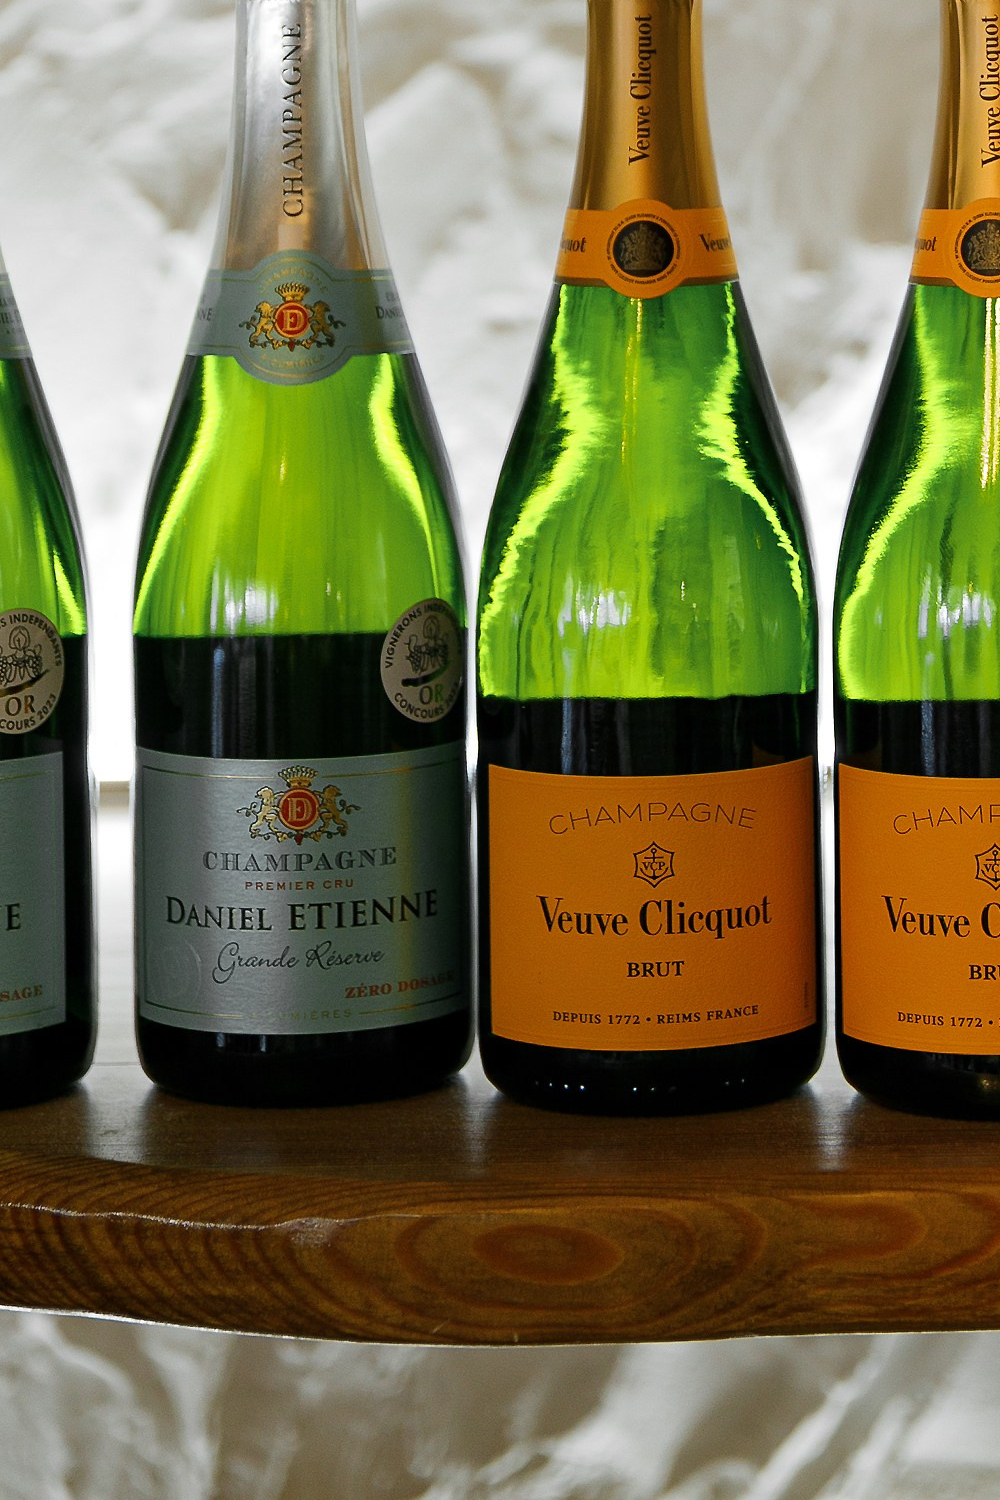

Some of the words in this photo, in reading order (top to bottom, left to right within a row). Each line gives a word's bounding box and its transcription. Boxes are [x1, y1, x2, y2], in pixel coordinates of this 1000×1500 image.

[629, 14, 657, 100] Clicquot
[282, 23, 304, 217] CHAMPAGNE
[628, 105, 651, 166] Veuve
[384, 607, 423, 669] VIGNERONS
[4, 694, 36, 717] OR
[394, 692, 445, 719] CONCOURS
[549, 802, 757, 835] CHAMPAGNE
[202, 846, 398, 873] CHAMPAGNE
[245, 880, 316, 891] PREMIER
[322, 878, 355, 889] CRU
[166, 895, 273, 931] DANIEL
[287, 889, 439, 931] ETIENNE
[536, 895, 629, 936] Veuve
[639, 895, 772, 939] Clicquot
[881, 895, 970, 938] Veuve
[212, 941, 300, 984] Grande
[305, 940, 385, 970] Réserve
[626, 960, 685, 978] BRUT
[344, 981, 392, 999] ZÉRO
[397, 970, 455, 993] DOSAGE
[552, 1011, 602, 1025] DEPUIS
[608, 1014, 641, 1025] 1772
[656, 1012, 701, 1025] REIMS
[706, 1005, 759, 1022] FRANCE
[897, 1011, 945, 1026] DEPUIS
[950, 1016, 983, 1028] 1772
